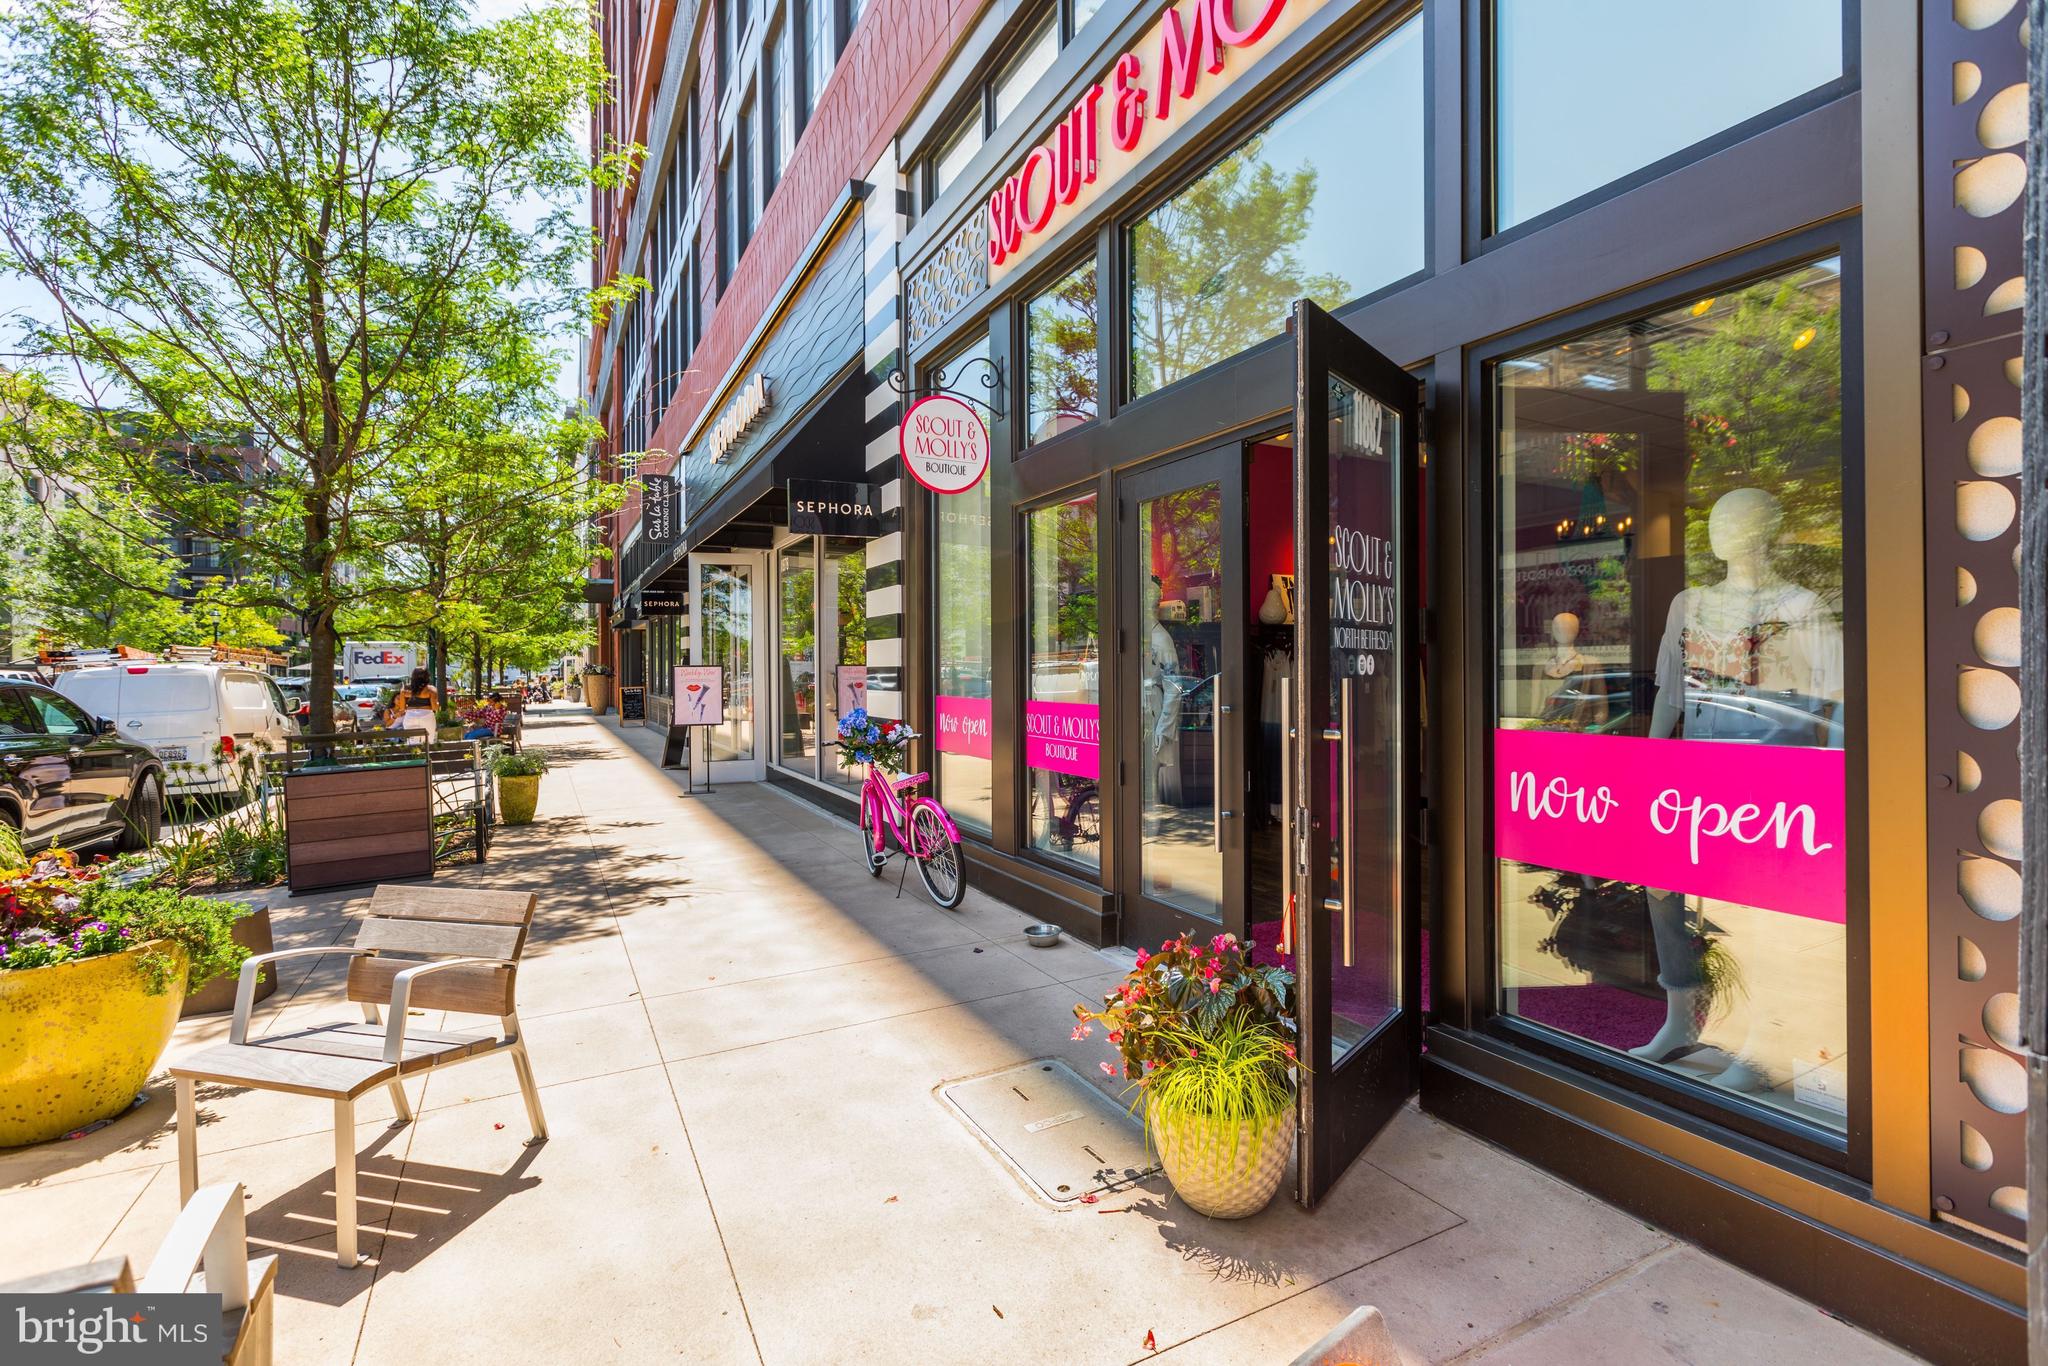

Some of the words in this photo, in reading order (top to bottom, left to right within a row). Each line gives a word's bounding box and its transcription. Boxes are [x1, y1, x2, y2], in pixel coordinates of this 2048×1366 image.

[988, 83, 1104, 265] SCOUT
[1111, 52, 1148, 152] &
[709, 372, 766, 465] SEPHORA
[916, 414, 963, 438] SCOUT
[967, 421, 976, 440] &
[915, 436, 977, 461] MOLLY'S
[926, 461, 967, 476] BOUTIQUE
[648, 477, 662, 504] table
[796, 500, 873, 516] SEPHORA
[648, 518, 662, 540] Sur
[1335, 524, 1381, 577] SCOUT
[1385, 541, 1392, 579] &
[643, 600, 680, 608] SEPHORA
[1334, 576, 1395, 625] MOLLY'S
[1334, 627, 1360, 649] NORTH
[1361, 627, 1395, 651] BETHESDA
[354, 651, 405, 665] FedEx
[939, 712, 959, 733] now
[962, 715, 988, 745] open
[1026, 712, 1051, 735] SCOUT
[1054, 716, 1060, 735] &
[1062, 717, 1100, 741] MOLLY'S
[1045, 742, 1079, 762] BOUTIQUE
[1510, 770, 1619, 825] now
[1649, 788, 1832, 865] open
